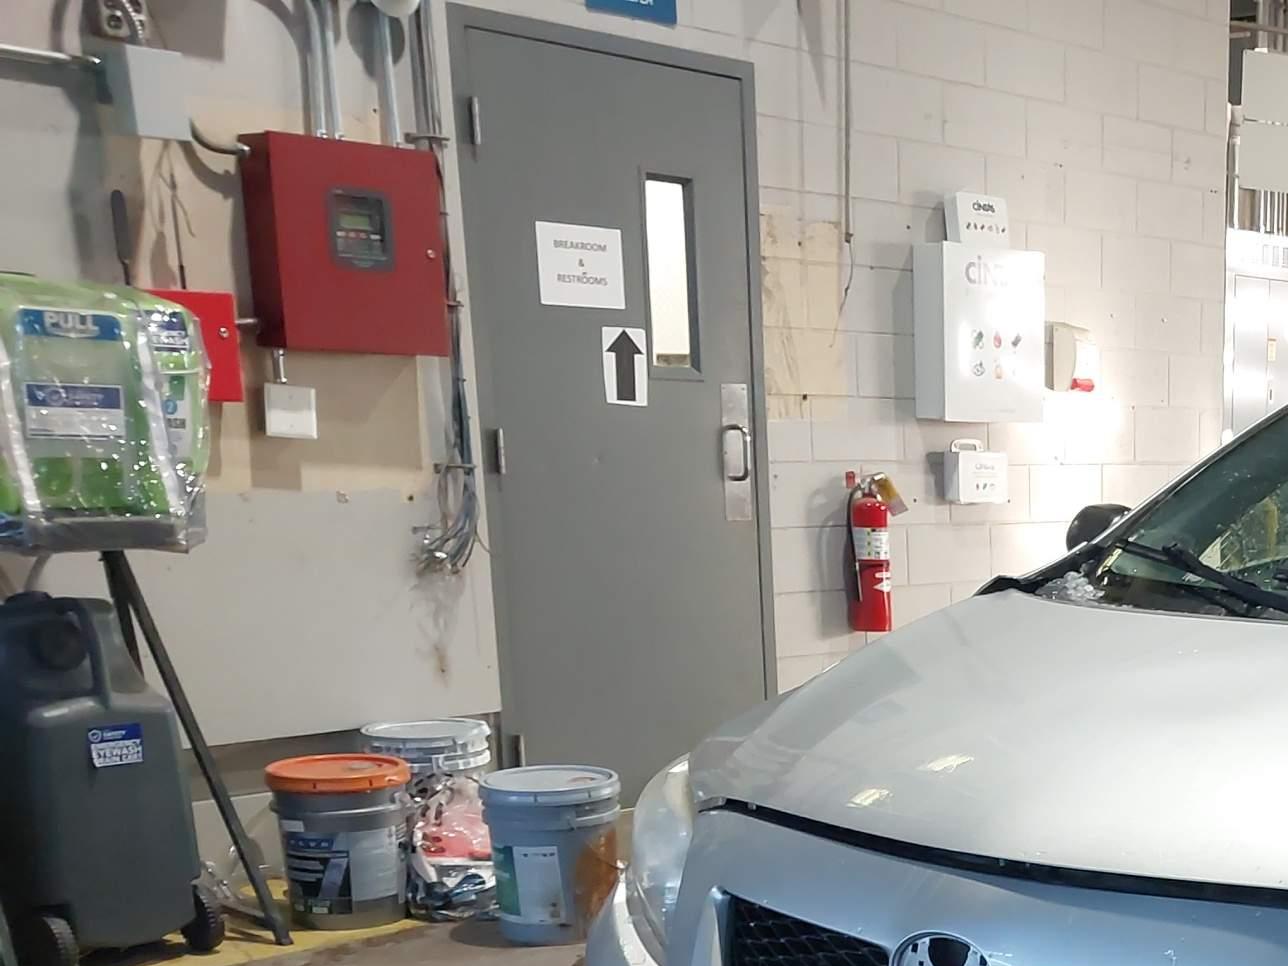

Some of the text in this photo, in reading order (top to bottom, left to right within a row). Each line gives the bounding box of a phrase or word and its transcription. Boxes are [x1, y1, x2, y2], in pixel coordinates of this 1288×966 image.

[553, 239, 607, 252] BREAKROOM
[578, 258, 585, 267] &
[557, 273, 608, 286] RESTROOMS
[43, 310, 97, 329] PULL
